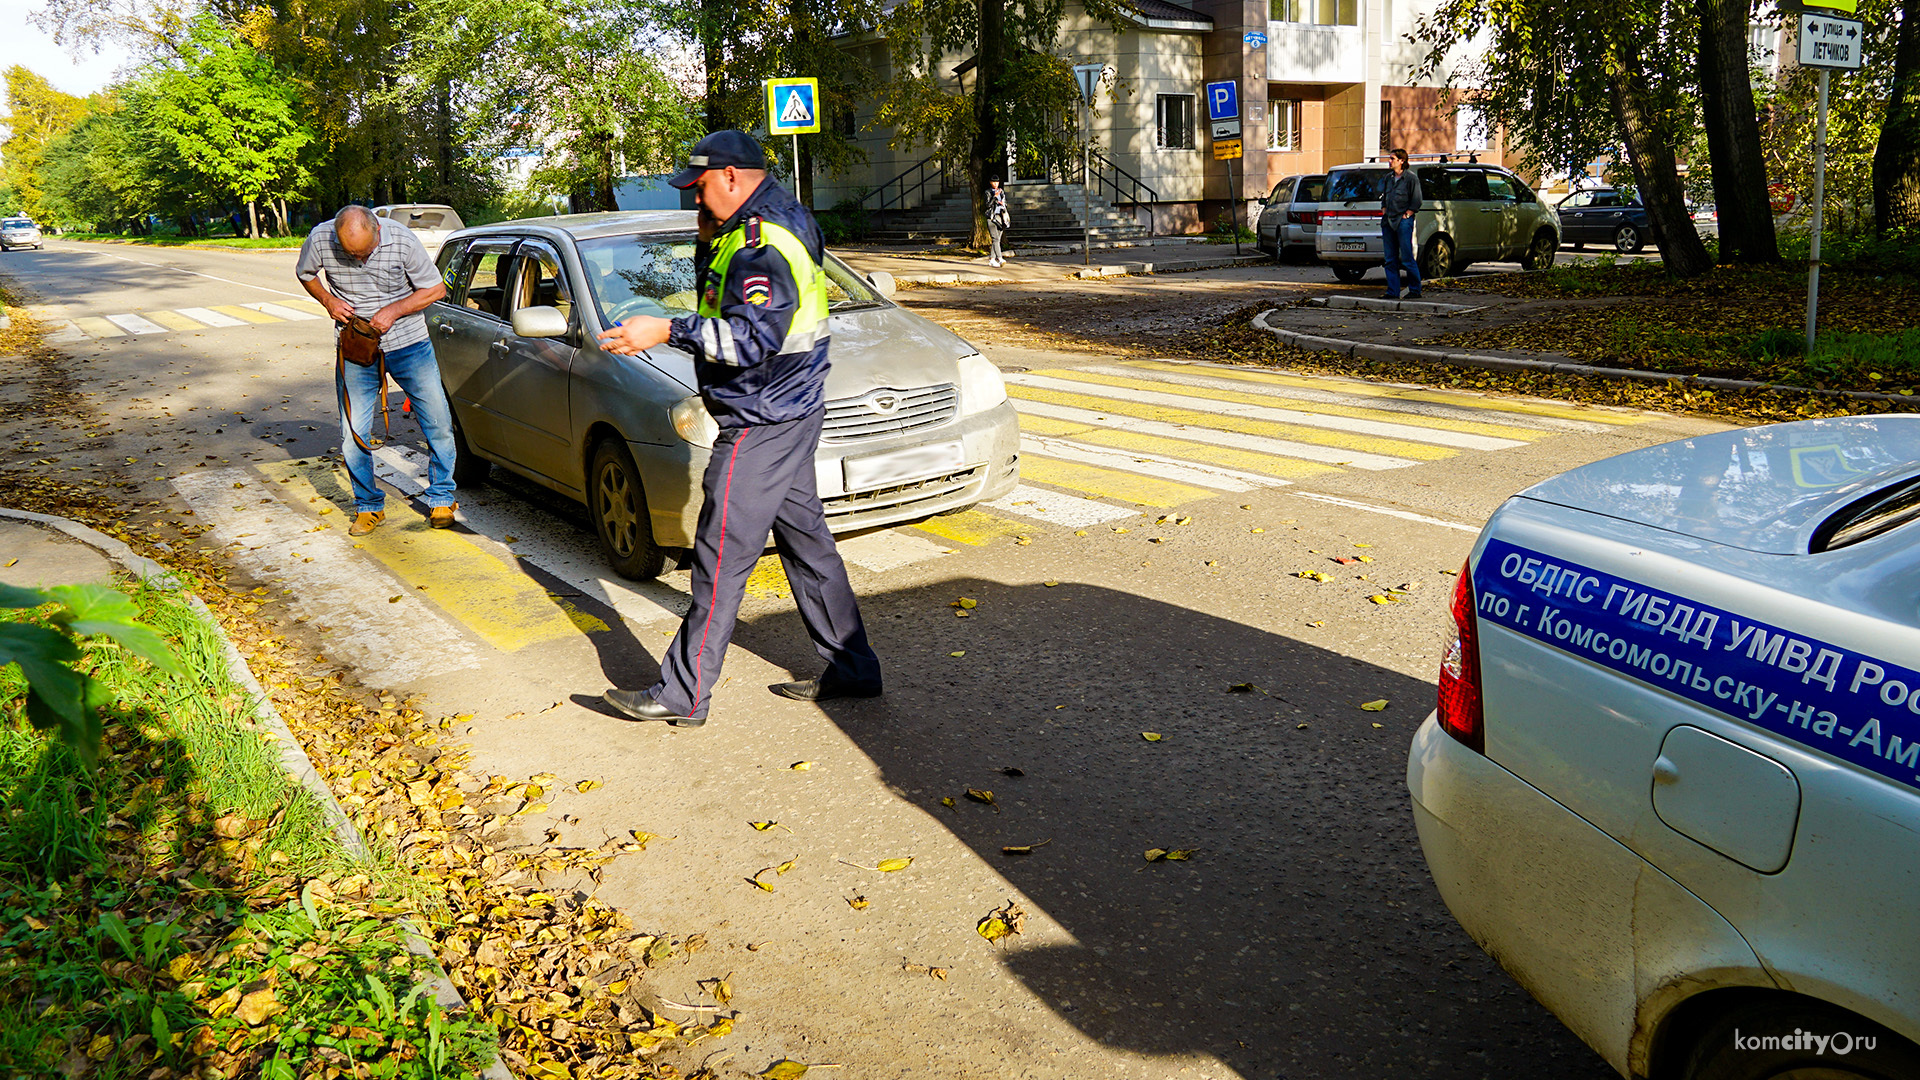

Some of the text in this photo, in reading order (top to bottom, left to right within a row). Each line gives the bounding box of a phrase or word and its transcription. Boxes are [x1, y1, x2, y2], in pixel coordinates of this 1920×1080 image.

[1813, 42, 1849, 61] ЛЕТЧИКОВ
[1823, 23, 1843, 38] улица
[1501, 553, 1599, 603] ОБДПС
[1602, 583, 1720, 650] ГИБДД
[1724, 620, 1843, 692] УМВД
[1480, 592, 1920, 783] по г. Комсомольску-на-Ам
